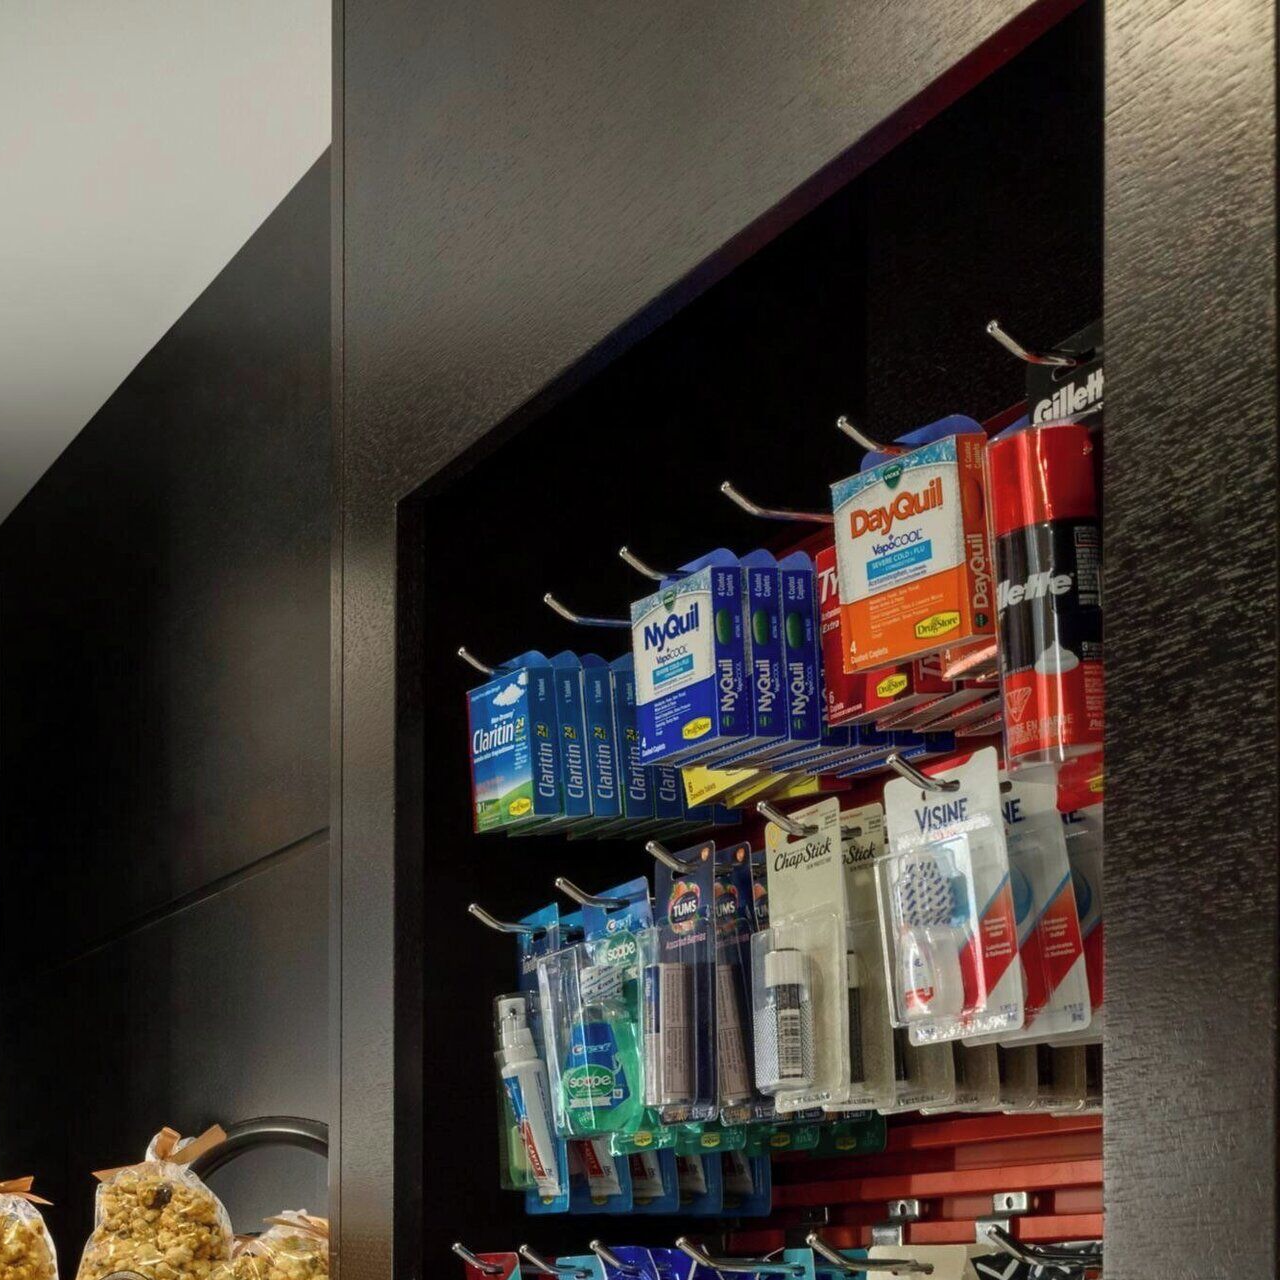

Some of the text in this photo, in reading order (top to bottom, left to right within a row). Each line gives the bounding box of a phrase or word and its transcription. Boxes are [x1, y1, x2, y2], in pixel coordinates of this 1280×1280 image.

[850, 476, 944, 540] DayQuil
[871, 529, 923, 556] VapoCOOL
[871, 556, 893, 571] SEVERE
[966, 532, 990, 610] DayQuil
[644, 602, 699, 652] NyQuil
[849, 640, 858, 656] 4
[719, 659, 739, 713] NyQuil
[755, 658, 776, 713] NyQuil
[790, 661, 810, 716] NyQuil
[473, 721, 514, 755] Claritin
[539, 742, 556, 798] Claritin
[568, 744, 584, 799] Claritin
[597, 744, 614, 800] Claritin
[914, 797, 969, 834] VISINE
[774, 836, 832, 872] ChapStick
[673, 900, 697, 918] TUMS
[607, 940, 636, 962] scope
[569, 1074, 612, 1091] scope
